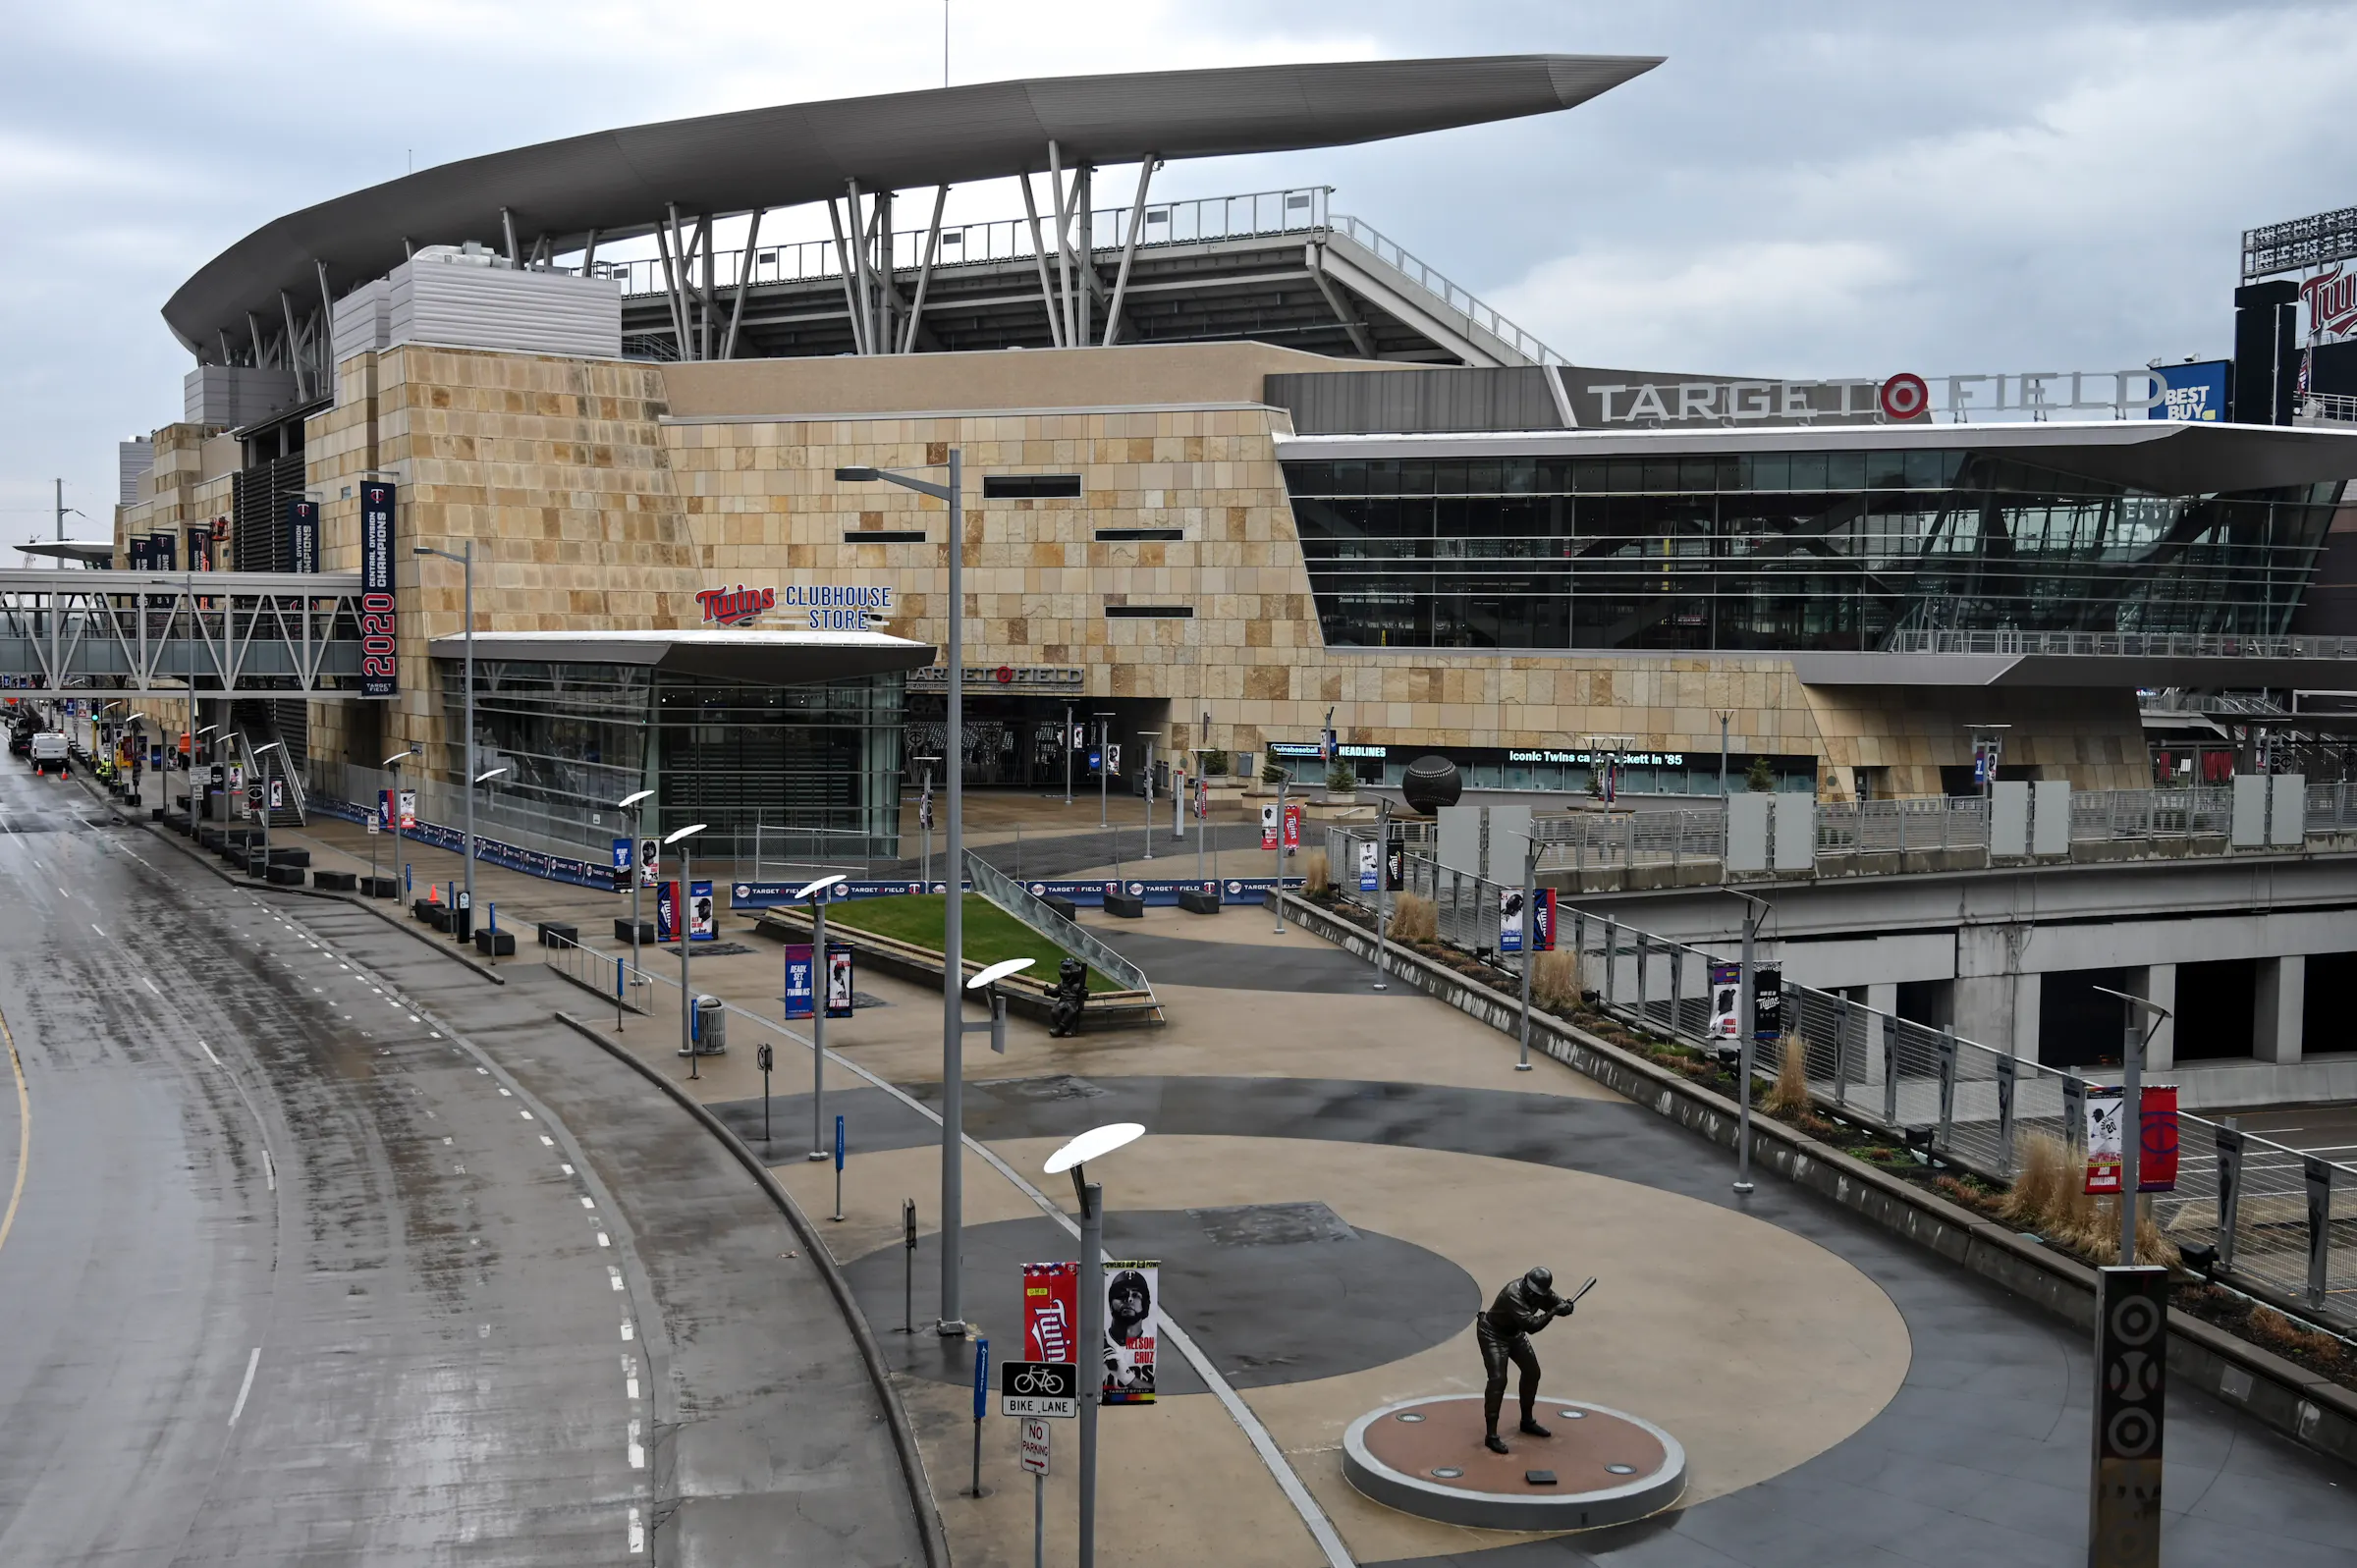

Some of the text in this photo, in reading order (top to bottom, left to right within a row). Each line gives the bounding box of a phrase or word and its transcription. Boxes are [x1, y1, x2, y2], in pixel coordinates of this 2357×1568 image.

[1588, 369, 2167, 422] TARGET FIELD
[2165, 386, 2210, 406] BEST
[2167, 403, 2207, 421] BUY
[376, 512, 387, 588] CHAMPIONS
[695, 583, 776, 626] Twins
[786, 586, 893, 607] CLUBHOUSE
[809, 609, 868, 630] STORE
[362, 592, 396, 676] 2020
[1015, 668, 1084, 682] FIELD
[1339, 746, 1386, 757] HEADLINES
[1509, 751, 1542, 762] Iconic
[1544, 751, 1575, 762] Twins
[1652, 754, 1663, 764] in
[1665, 755, 1683, 766] '85
[1286, 816, 1297, 839] Twins
[1755, 996, 1781, 1010] Twins
[2106, 1121, 2117, 1134] 20
[1031, 1299, 1071, 1362] Twin
[1125, 1336, 1154, 1350] NELSON
[1134, 1351, 1154, 1364] CRUZ
[1010, 1400, 1068, 1412] BIKE LANE
[1029, 1424, 1043, 1440] NO
[1023, 1440, 1049, 1457] PARKING
